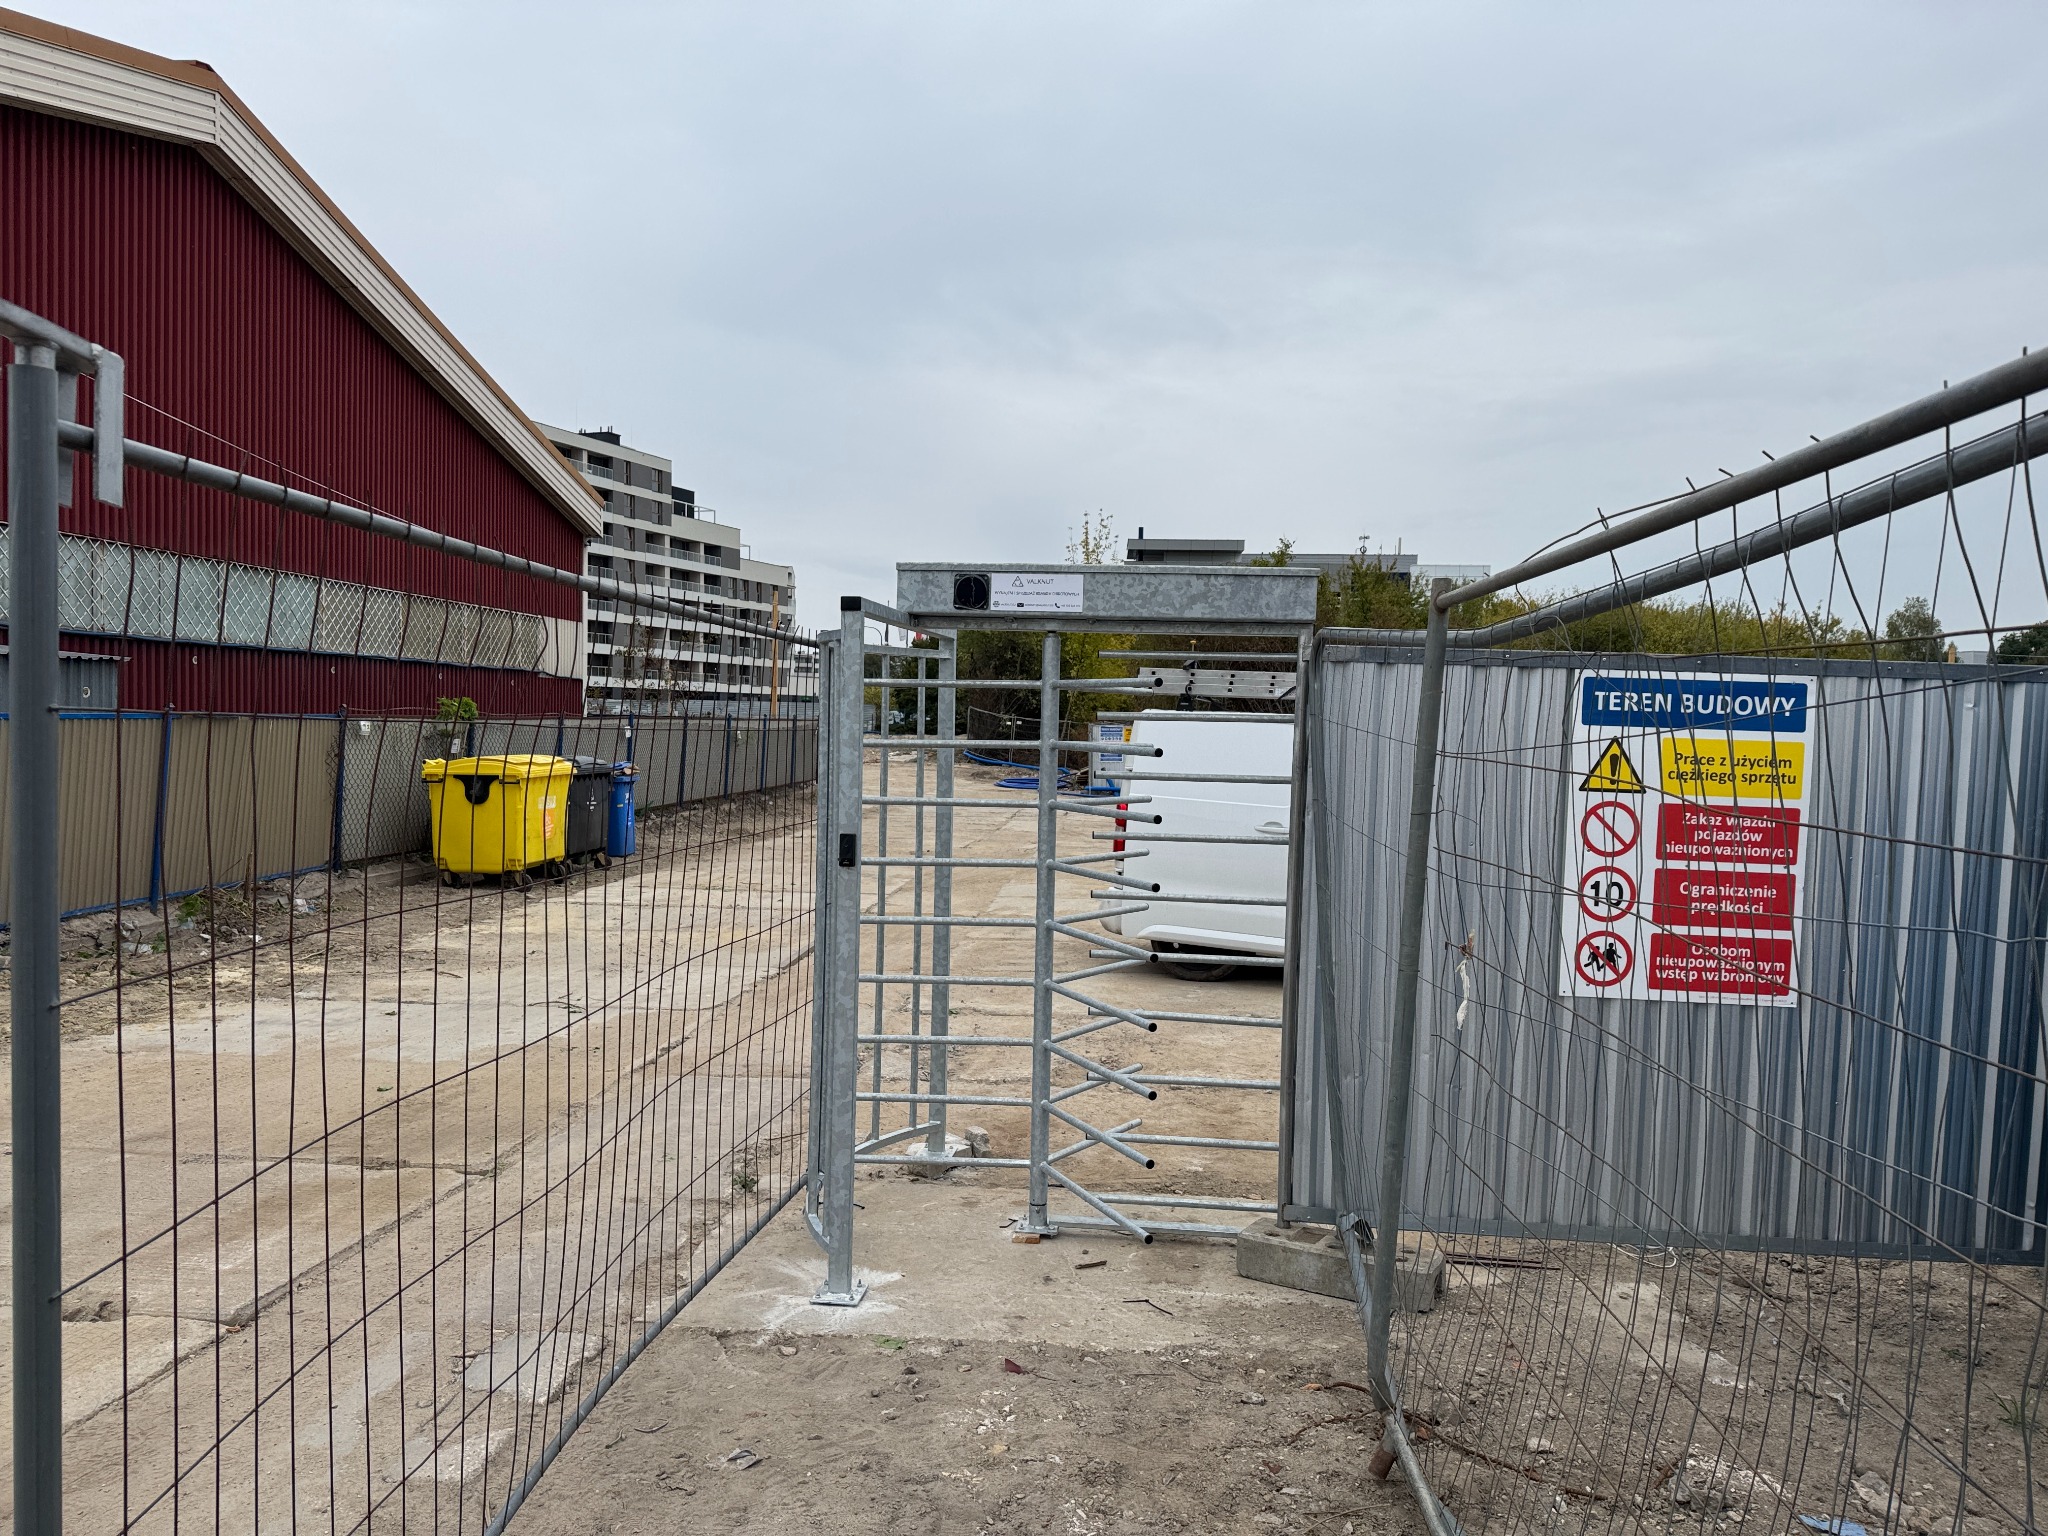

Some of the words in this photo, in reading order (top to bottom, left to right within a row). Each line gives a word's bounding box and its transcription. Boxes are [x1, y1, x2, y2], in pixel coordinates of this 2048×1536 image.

[1594, 691, 1673, 713] TEREN
[1680, 693, 1796, 717] BUDOWY
[1674, 752, 1716, 766] Prace
[1719, 756, 1727, 767] z
[1732, 754, 1793, 771] użyciem
[1667, 768, 1737, 785] ciężkiego
[1740, 771, 1797, 786] sprzętu
[1682, 812, 1723, 826] Zakaz
[1694, 827, 1763, 843] pojazdów
[1662, 840, 1794, 860] nieupoważnionych
[1590, 880, 1624, 907] 10
[1679, 881, 1777, 899] Ograniczenie
[1691, 899, 1765, 916] prędkości
[1691, 943, 1751, 958] Osobom
[1655, 953, 1786, 974] nieupoważnionym
[1655, 968, 1698, 983] wstęp
[1701, 968, 1785, 987] wzbronony
